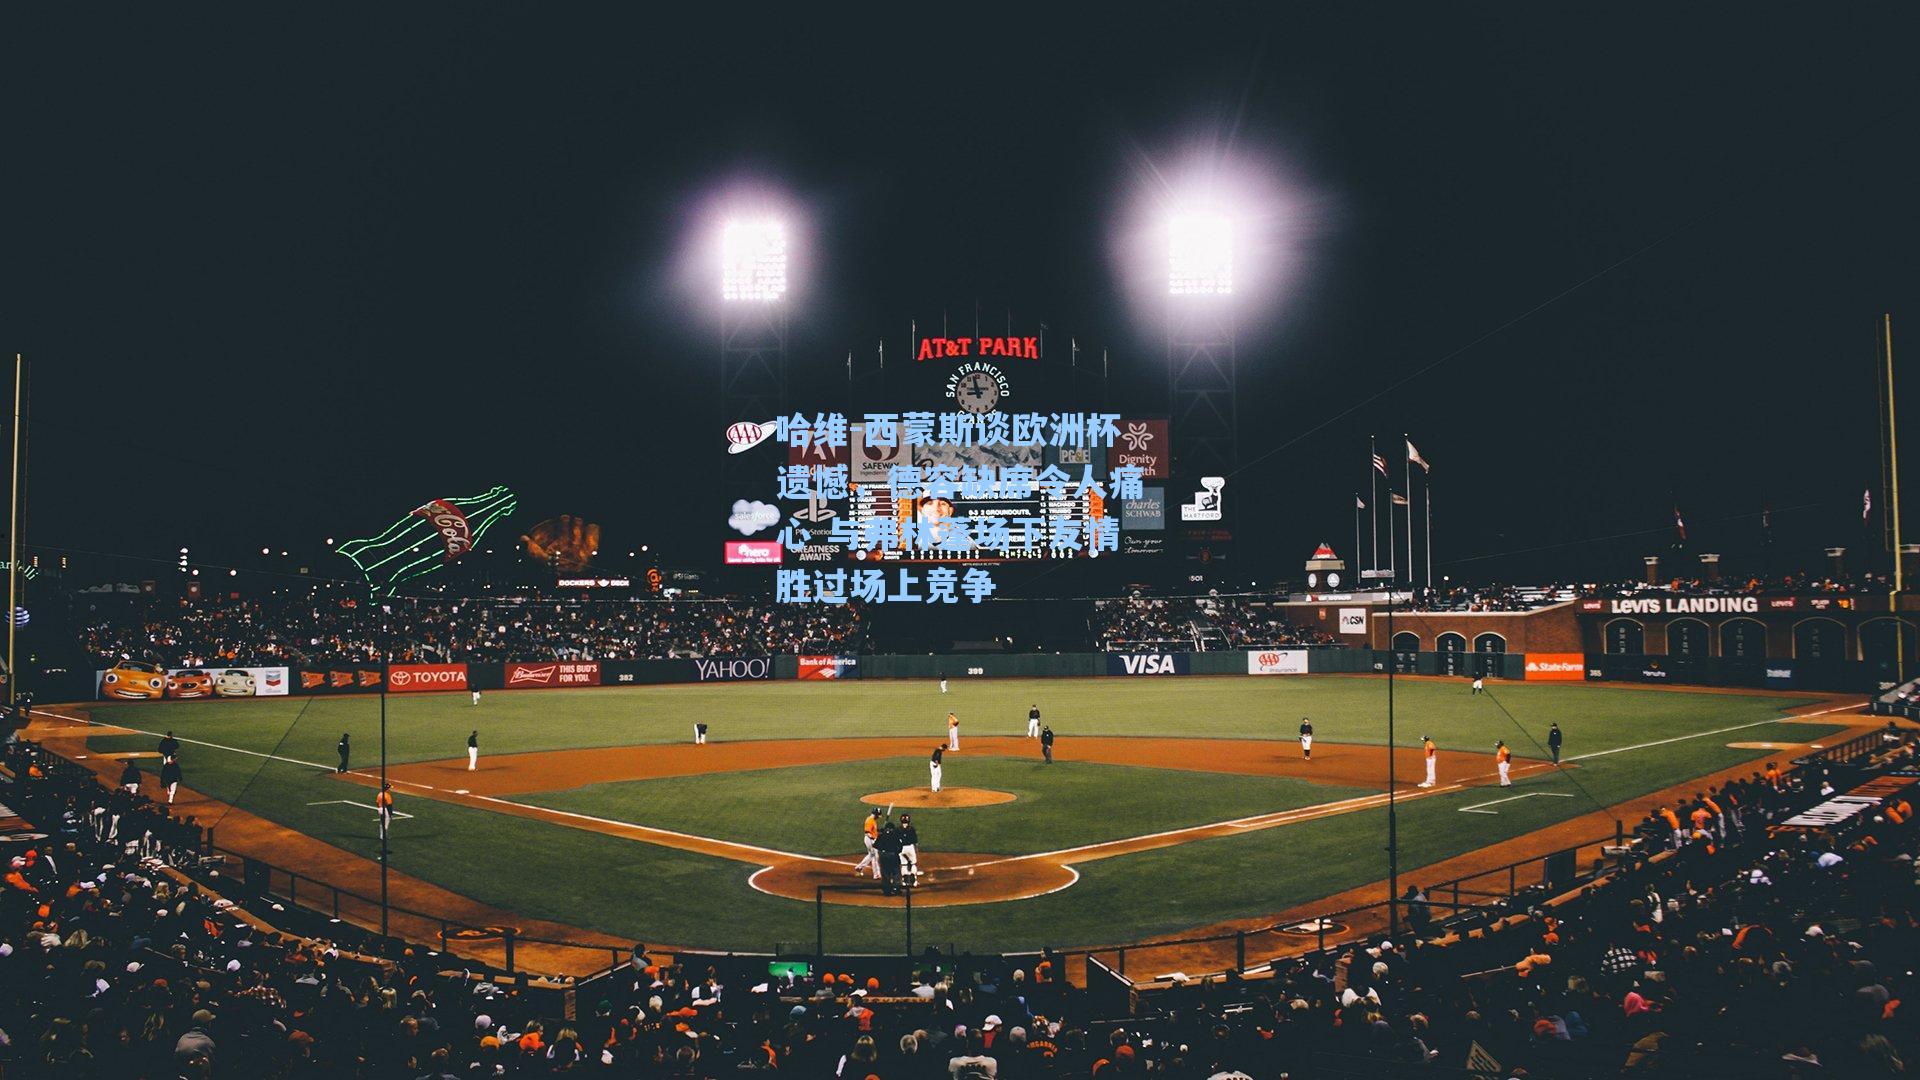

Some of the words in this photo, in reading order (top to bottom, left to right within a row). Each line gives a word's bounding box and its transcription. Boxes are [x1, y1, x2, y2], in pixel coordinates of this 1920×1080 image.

[917, 337, 972, 361] AT&T
[979, 336, 1039, 360] PARK
[945, 373, 960, 398] SAN
[957, 361, 1010, 397] FRANCISCO
[1061, 449, 1089, 462] PG&E
[1119, 454, 1157, 467] Dignity
[1125, 498, 1160, 510] charles
[734, 512, 775, 521] salesforce
[1125, 510, 1161, 518] SCHWAB
[434, 514, 471, 554] Cola
[1143, 539, 1163, 548] your
[798, 553, 832, 561] AWAITS
[1665, 596, 1758, 613] LANDING
[1349, 616, 1364, 625] CSN
[799, 658, 819, 666] Bank
[818, 658, 827, 666] of
[830, 658, 857, 666] America
[1119, 654, 1176, 674] VISA
[514, 670, 552, 679] Budweiser
[559, 664, 576, 673] THIS
[576, 664, 598, 673] BUD'S
[695, 658, 771, 680] YAHOO!
[413, 671, 467, 683] TOYOTA
[559, 674, 573, 682] FOR
[574, 674, 590, 682] YOU.
